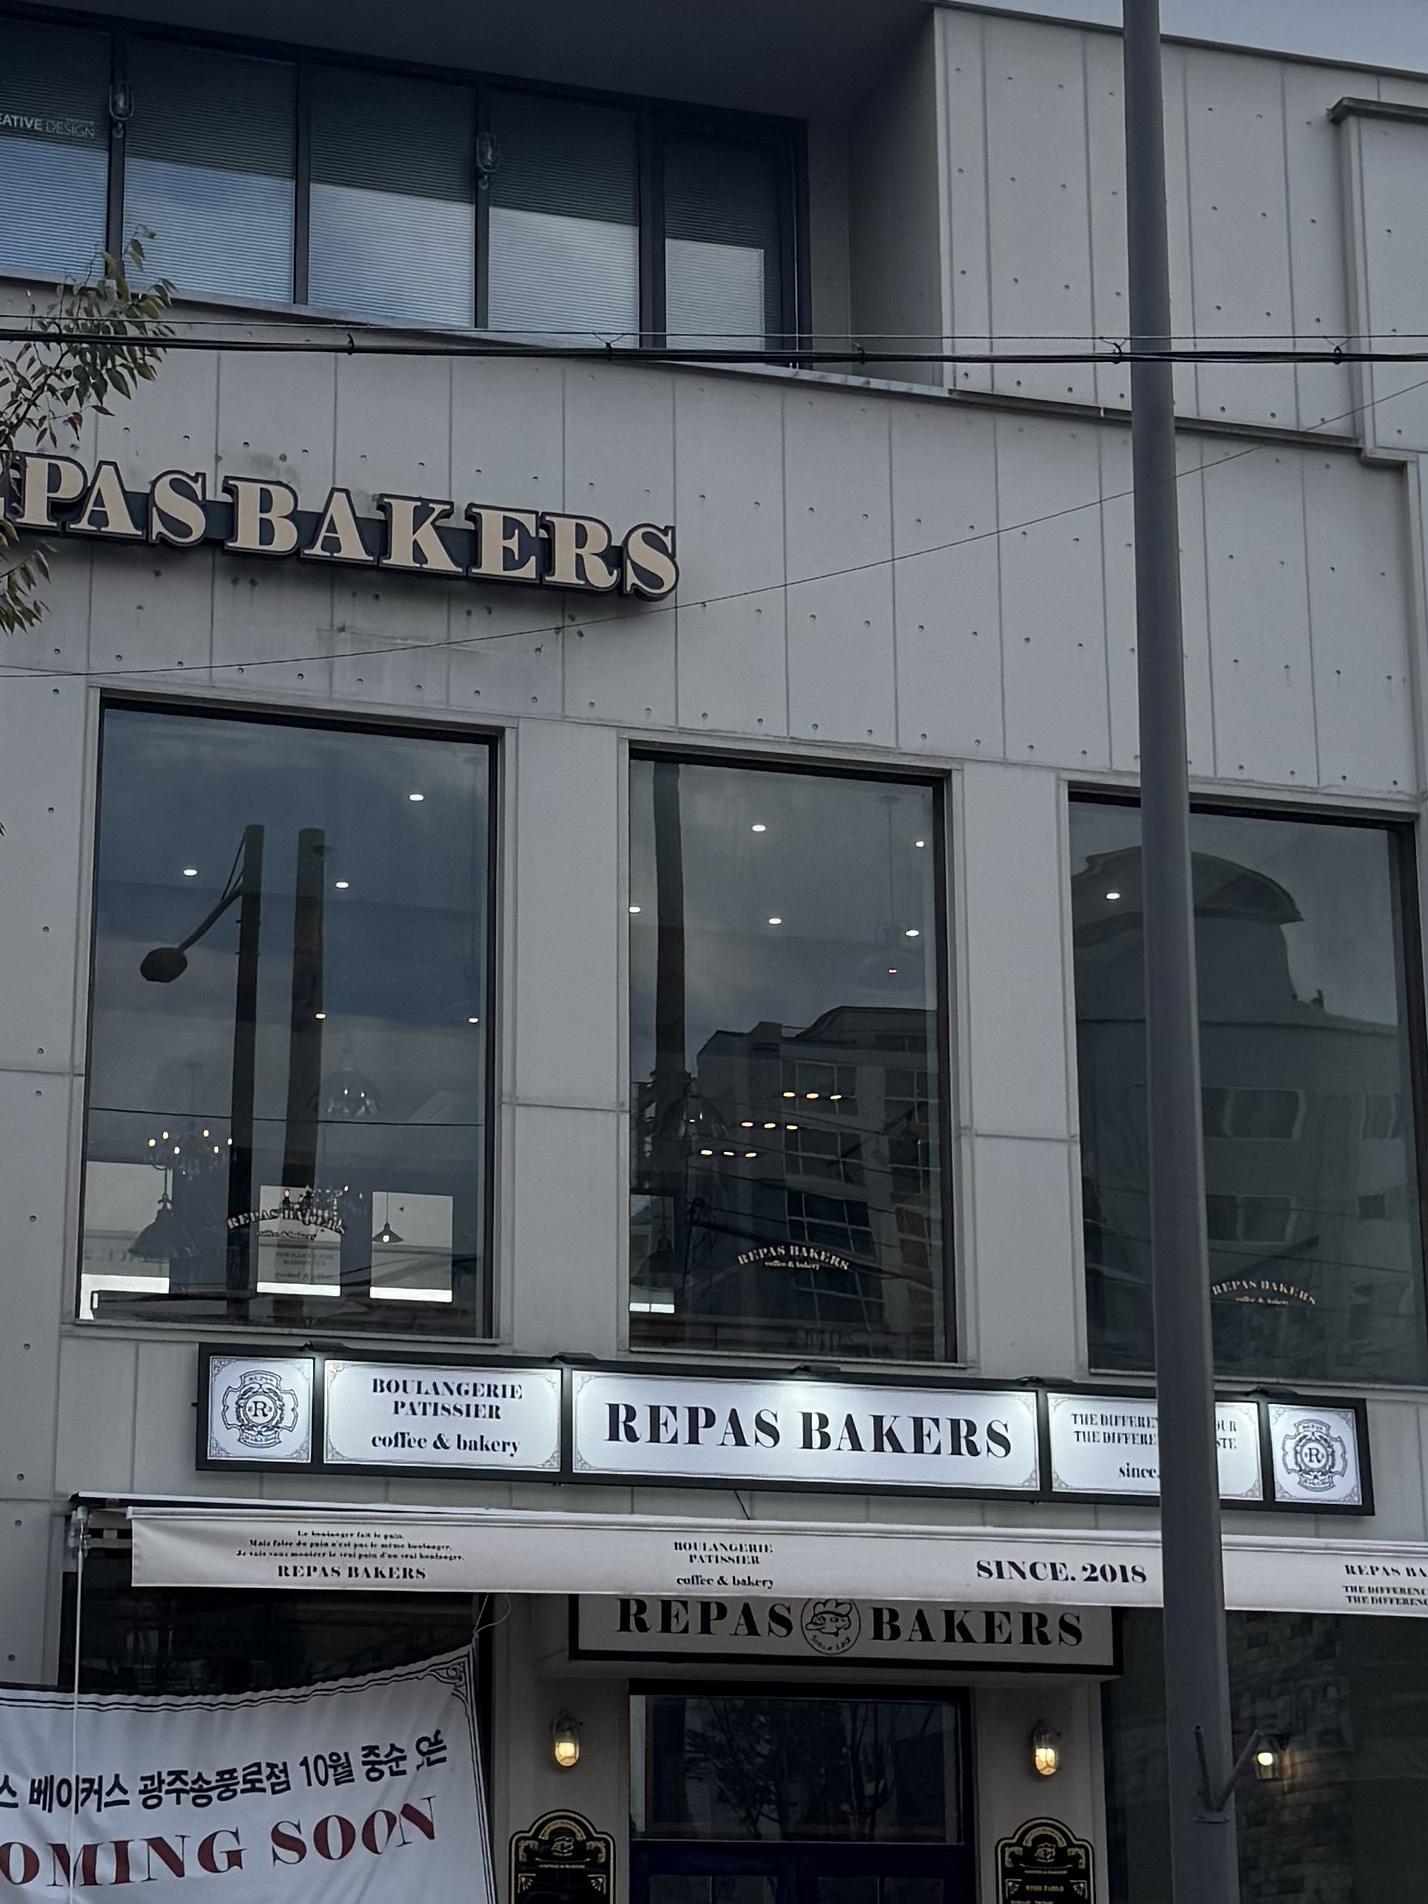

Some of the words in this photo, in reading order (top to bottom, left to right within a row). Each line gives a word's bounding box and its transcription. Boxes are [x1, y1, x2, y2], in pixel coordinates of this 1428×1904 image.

[737, 1245, 786, 1265] REPAS
[789, 1245, 850, 1271] BAKERS
[372, 1377, 523, 1400] BOULANGERIE
[252, 1400, 269, 1418] R
[392, 1400, 502, 1421] PATISSIER
[1071, 1413, 1098, 1426] THE
[1100, 1414, 1159, 1429] DIFFERE
[604, 1402, 781, 1449] REPAS
[798, 1410, 1012, 1459] BAKERS
[1074, 1430, 1100, 1443] THE
[1103, 1431, 1159, 1445] DIFFERE
[371, 1431, 428, 1450] coffee
[431, 1433, 451, 1450] &
[456, 1433, 521, 1457] bakery
[1308, 1448, 1322, 1464] R
[673, 1541, 774, 1553] BOULANGERIE
[688, 1554, 761, 1565] PATISSIER
[277, 1565, 341, 1578] REPAS
[347, 1566, 427, 1580] BAKERS
[975, 1559, 1077, 1583] SINCE.
[1081, 1561, 1148, 1584] 2018
[1344, 1564, 1401, 1577] REPAS
[676, 1574, 714, 1586] coffee
[716, 1575, 729, 1586] &
[732, 1575, 774, 1590] bakery
[1342, 1585, 1366, 1594] THE
[1346, 1595, 1369, 1605] THE
[617, 1596, 793, 1639] REPAS
[871, 1603, 1084, 1649] BAKERS
[28, 1773, 131, 1815] 베이커스
[138, 1761, 292, 1811] 광주송풍로점
[298, 1751, 355, 1787] 10월
[360, 1742, 408, 1783] 중순
[270, 1795, 437, 1868] SOON
